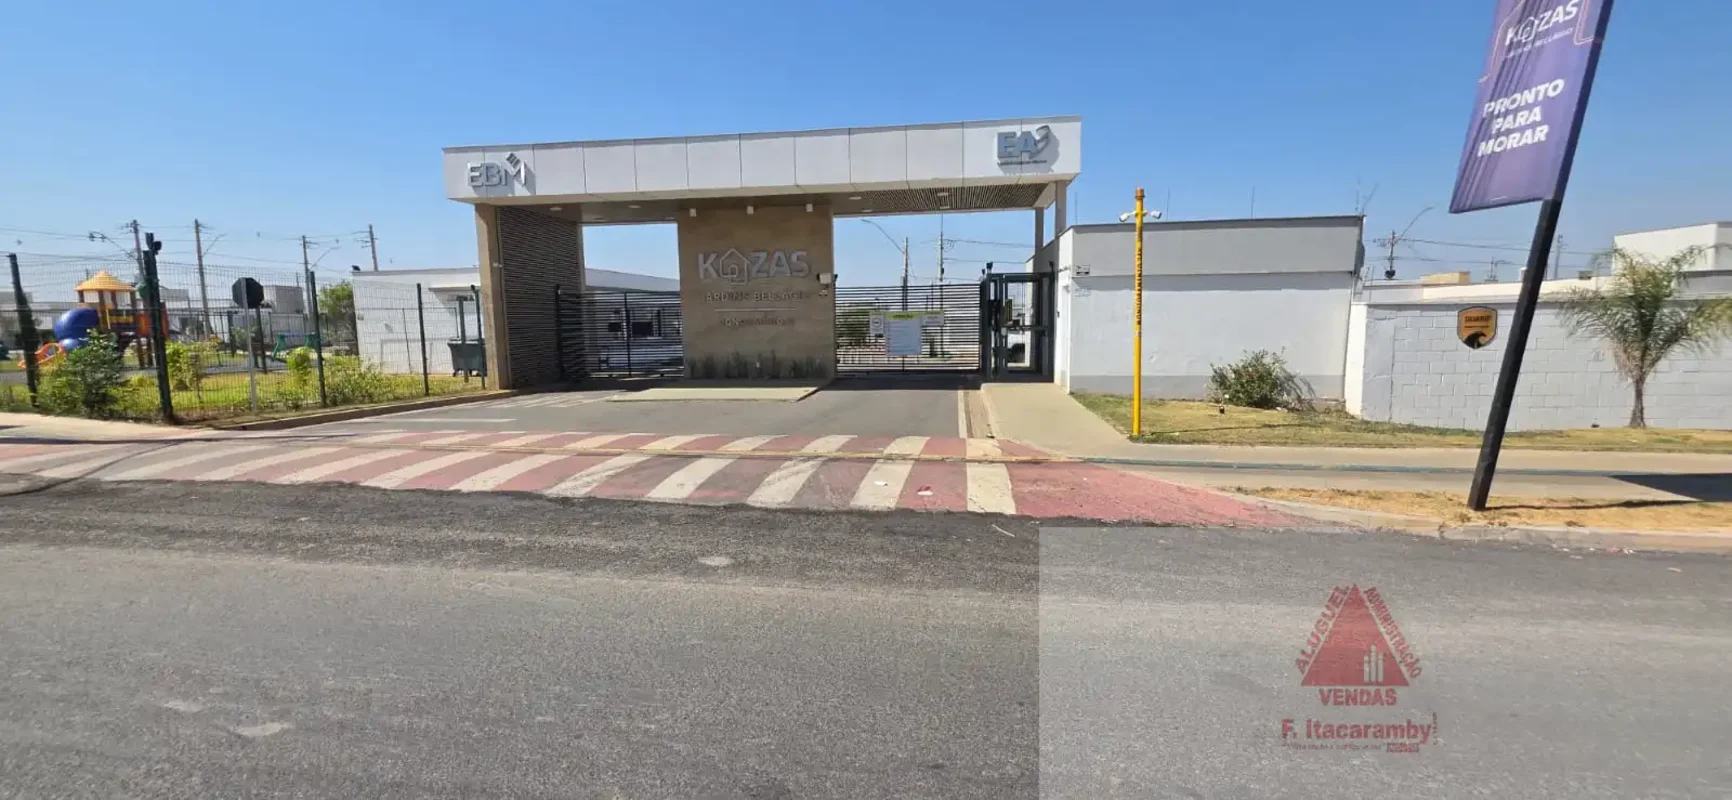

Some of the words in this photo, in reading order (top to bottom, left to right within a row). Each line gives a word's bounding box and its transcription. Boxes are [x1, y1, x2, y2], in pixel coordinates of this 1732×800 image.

[1483, 79, 1565, 117] PRONTO
[1492, 106, 1542, 134] PARA
[1477, 124, 1549, 157] MORAR
[467, 152, 527, 187] EBM
